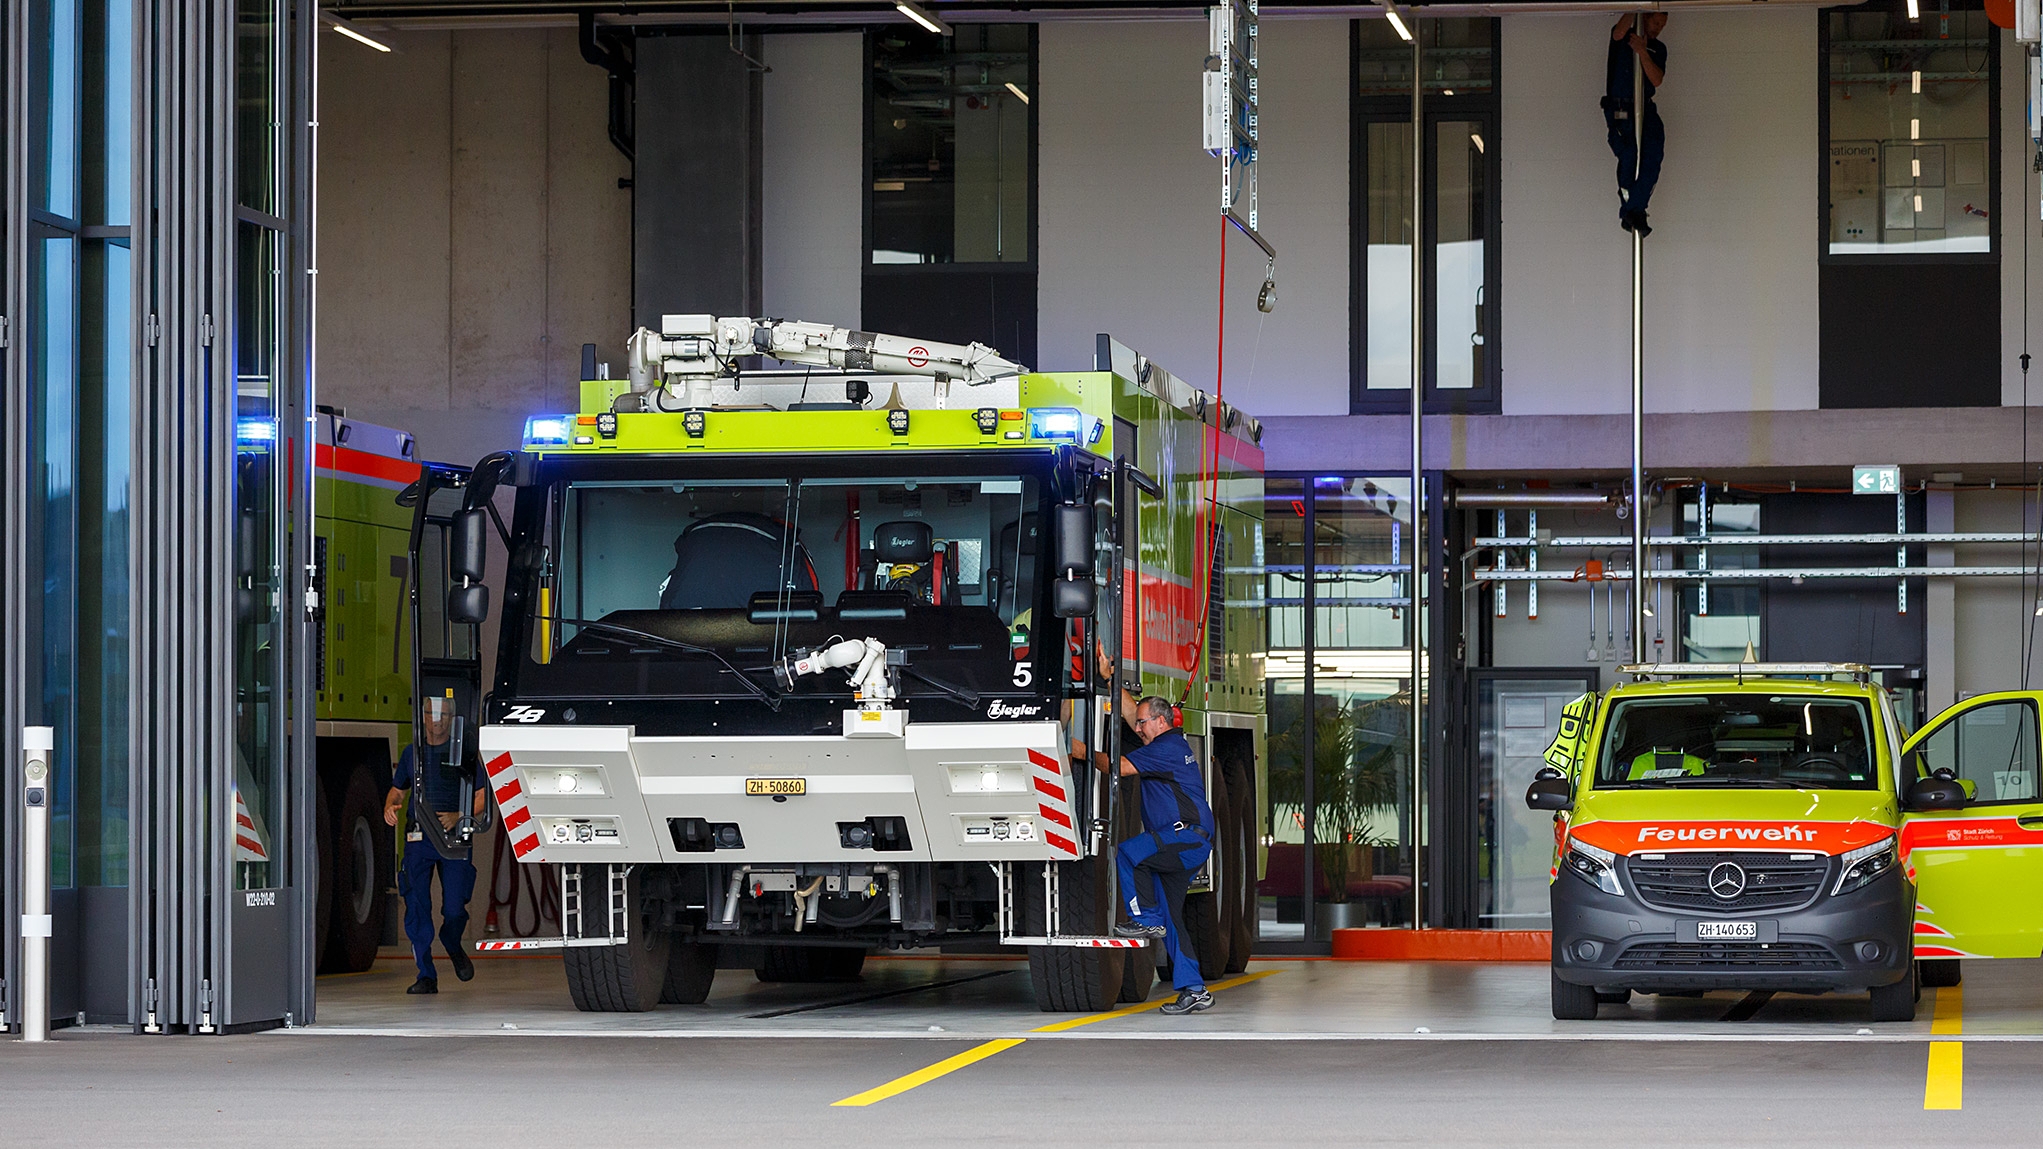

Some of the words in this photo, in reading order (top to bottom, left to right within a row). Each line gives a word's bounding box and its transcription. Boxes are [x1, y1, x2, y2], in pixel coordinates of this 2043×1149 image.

[891, 536, 915, 548] Ziegler
[1012, 661, 1032, 688] 5
[503, 705, 546, 723] Z8
[987, 699, 1041, 720] Ziegler
[1637, 824, 1818, 842] Feuerwehr
